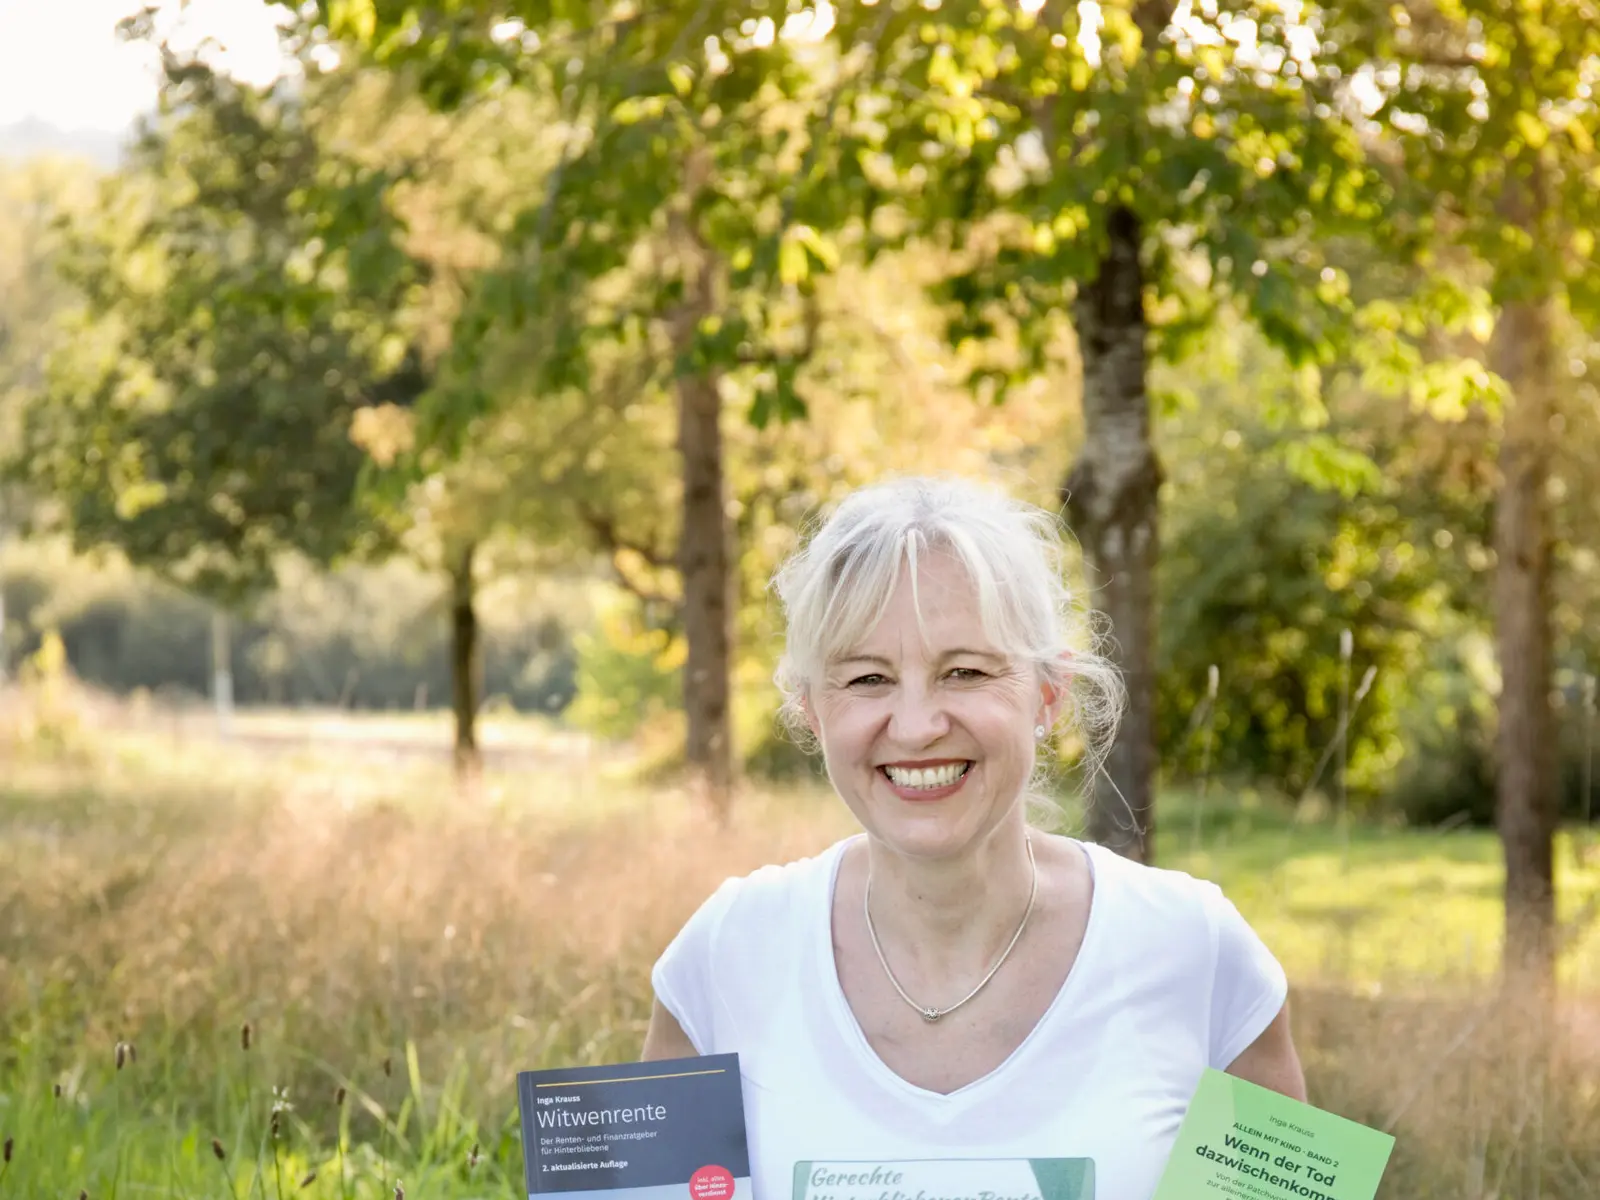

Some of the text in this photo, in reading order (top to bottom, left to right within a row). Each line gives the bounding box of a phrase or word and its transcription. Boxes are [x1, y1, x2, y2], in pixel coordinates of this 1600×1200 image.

[537, 1094, 581, 1105] Inga Krauss
[537, 1104, 666, 1128] Witwenrente
[1269, 1115, 1315, 1138] Inga Krauss
[540, 1130, 658, 1146] Der Renten- und Finanzratgeber
[1232, 1122, 1263, 1138] ALLEIN
[1263, 1133, 1280, 1145] MIT
[1279, 1139, 1302, 1154] KIND
[1307, 1148, 1332, 1165] BAND
[1332, 1160, 1339, 1168] 2
[541, 1143, 609, 1156] für Hinterbliebene
[542, 1159, 628, 1172] 2. aktualisierte Auflage
[1224, 1133, 1336, 1187] Wenn der Tod
[811, 1166, 903, 1187] Gerechte
[1206, 1179, 1220, 1188] zur
[1232, 1178, 1246, 1188] der
